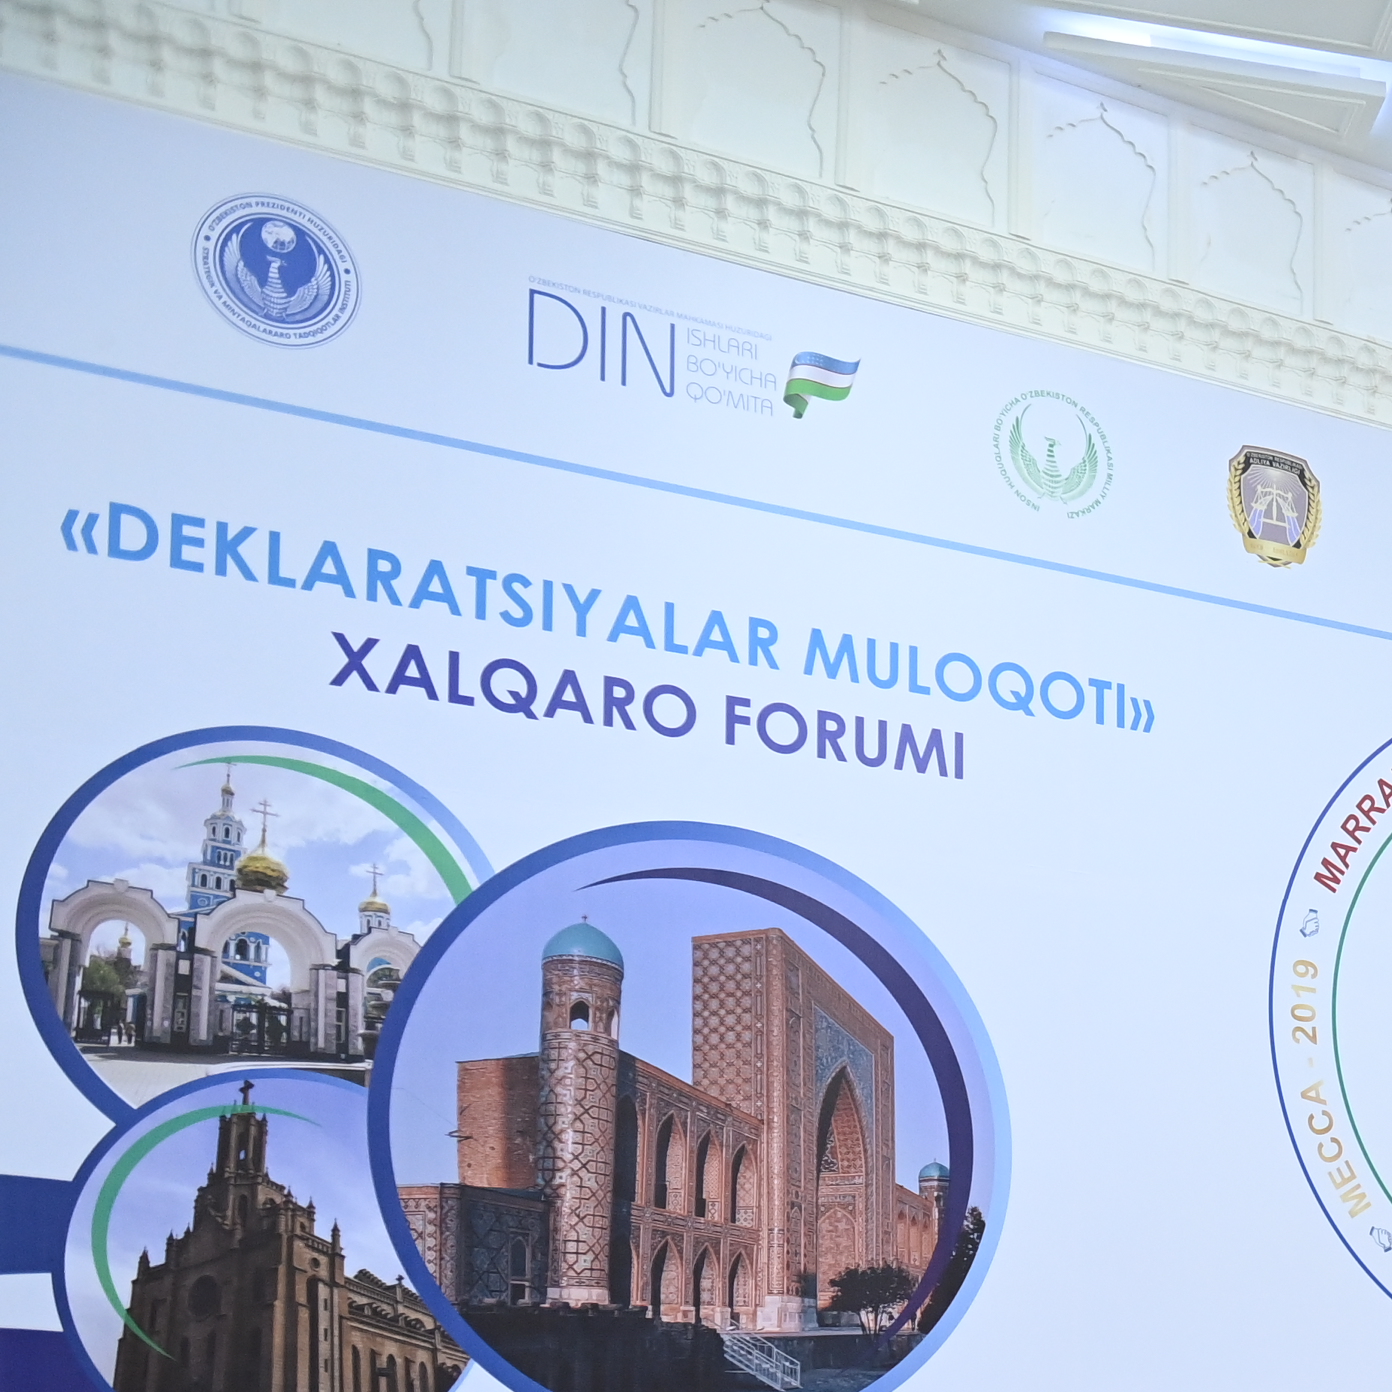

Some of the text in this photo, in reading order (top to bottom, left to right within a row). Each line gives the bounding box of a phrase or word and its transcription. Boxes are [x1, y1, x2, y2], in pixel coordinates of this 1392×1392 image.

[255, 200, 306, 220] PREZIDENTI
[307, 217, 349, 264] HUZURIDAGI
[213, 289, 223, 301] VA
[221, 300, 292, 340] MINTAQALARARO
[293, 314, 342, 340] TADQIQOTLAR
[340, 280, 352, 315] INSTITUTI
[582, 288, 637, 309] RESPUBLIKASI
[638, 302, 675, 318] VAZIRLAR
[725, 323, 773, 342] HUZURIDAGI
[528, 288, 675, 398] DIN
[687, 327, 758, 361] ISHLARI
[687, 354, 777, 391] BO'YICHA
[686, 382, 774, 417] QO'MITA
[1079, 406, 1114, 471] RESPUBLIKASI
[1014, 489, 1040, 512] INSON
[1067, 498, 1102, 519] MARKAZI
[1099, 472, 1114, 500] MILLIY
[60, 501, 1156, 733] «DEKLARATSIYALAR MULOQOTI»
[329, 631, 964, 780] XALQARO FORUMI
[1290, 958, 1320, 1046] 2019
[1299, 1079, 1372, 1219] MECCA
